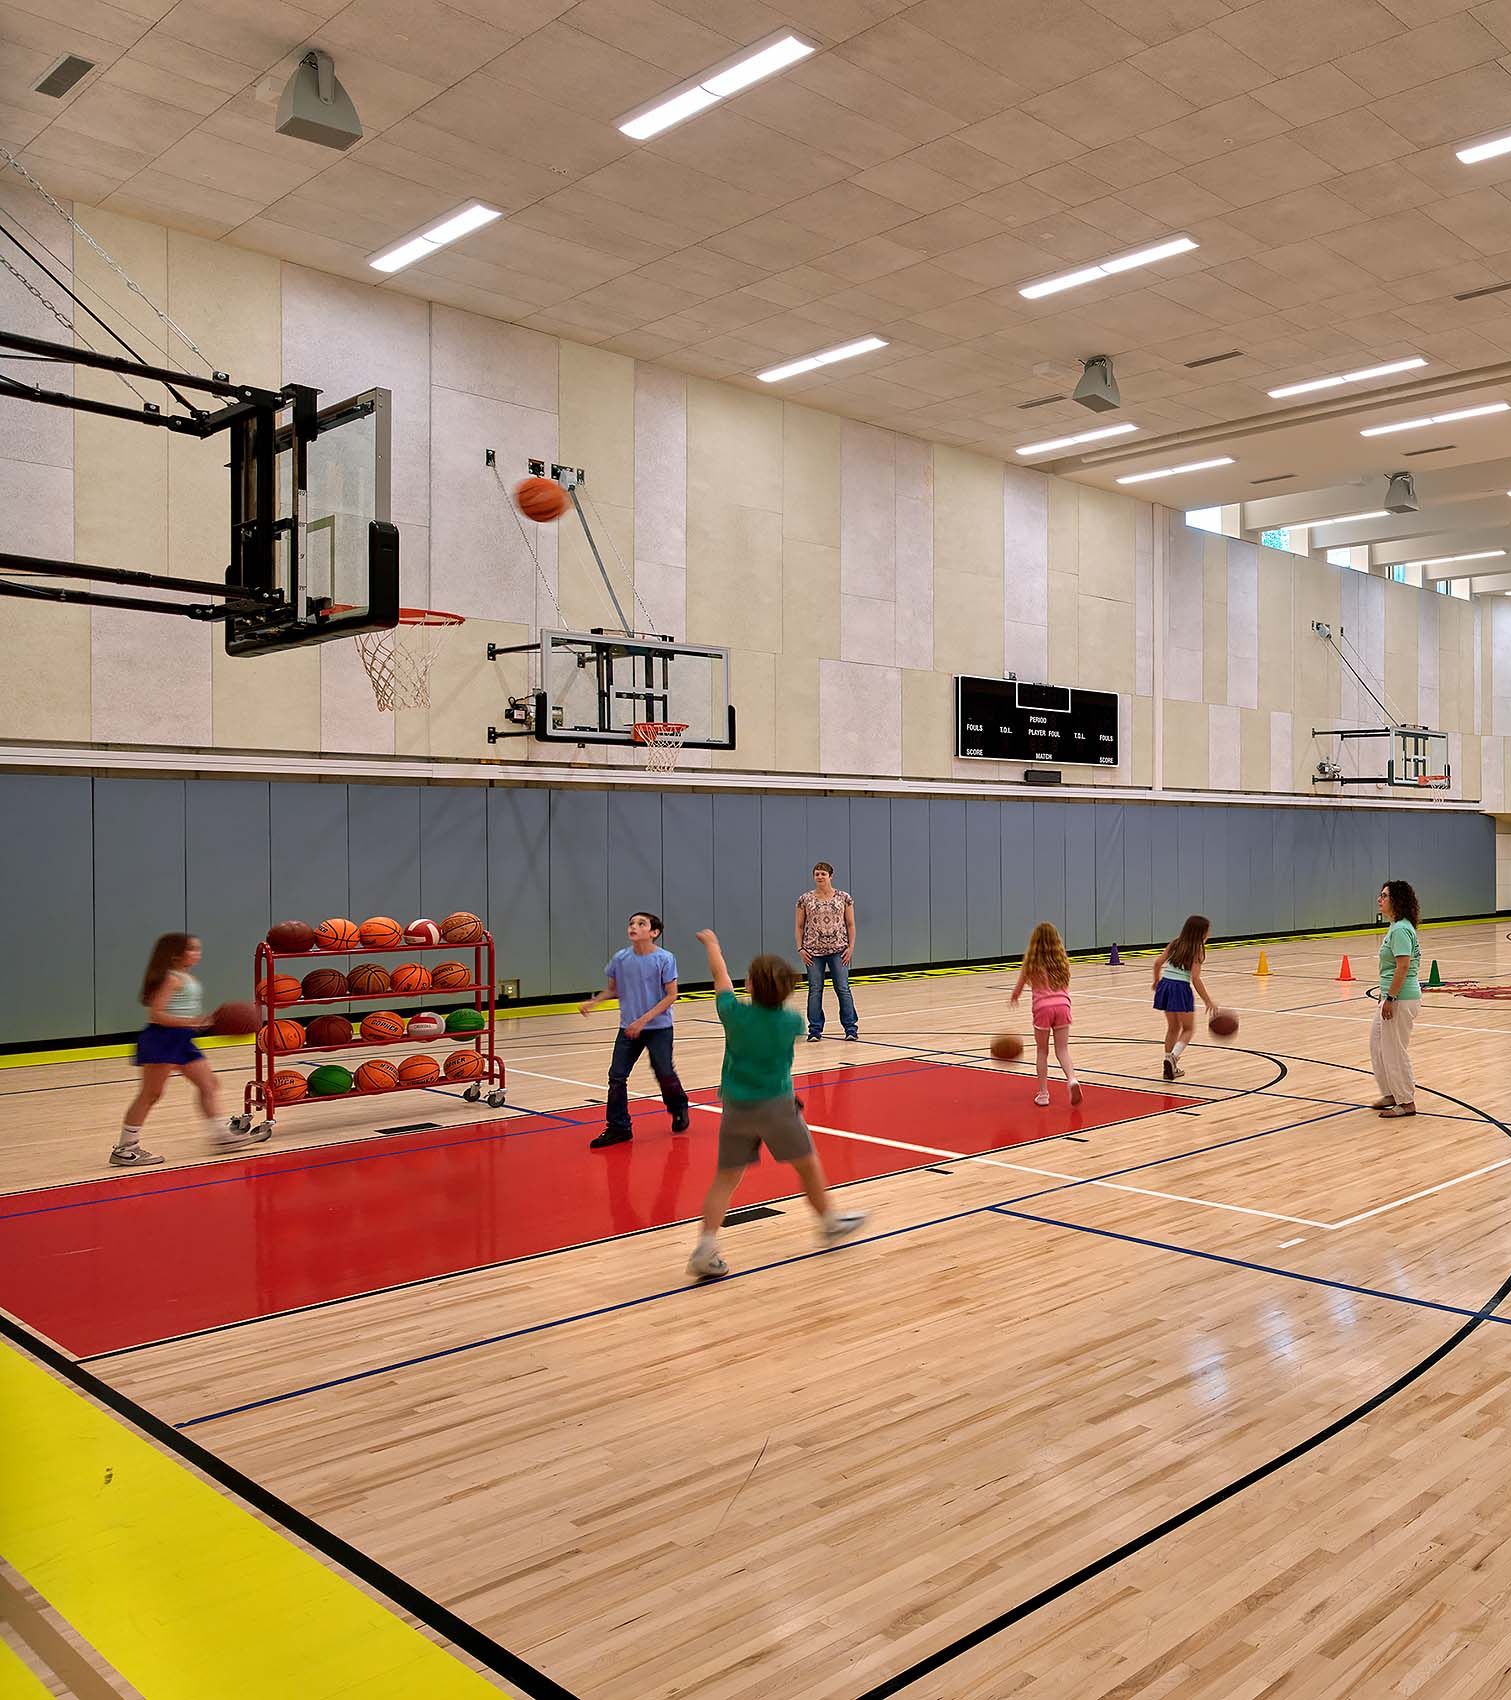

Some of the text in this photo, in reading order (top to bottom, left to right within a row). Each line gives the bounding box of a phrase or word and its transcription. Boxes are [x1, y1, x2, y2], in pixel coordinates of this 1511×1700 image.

[1029, 715, 1047, 724] PERIOD
[966, 723, 984, 732] FOULS
[1028, 728, 1061, 738] PLAYER FOUL
[1099, 734, 1114, 742] FOULS
[966, 748, 984, 756] SCORE
[1035, 752, 1053, 760] MATCH
[1099, 756, 1114, 764] SCORE
